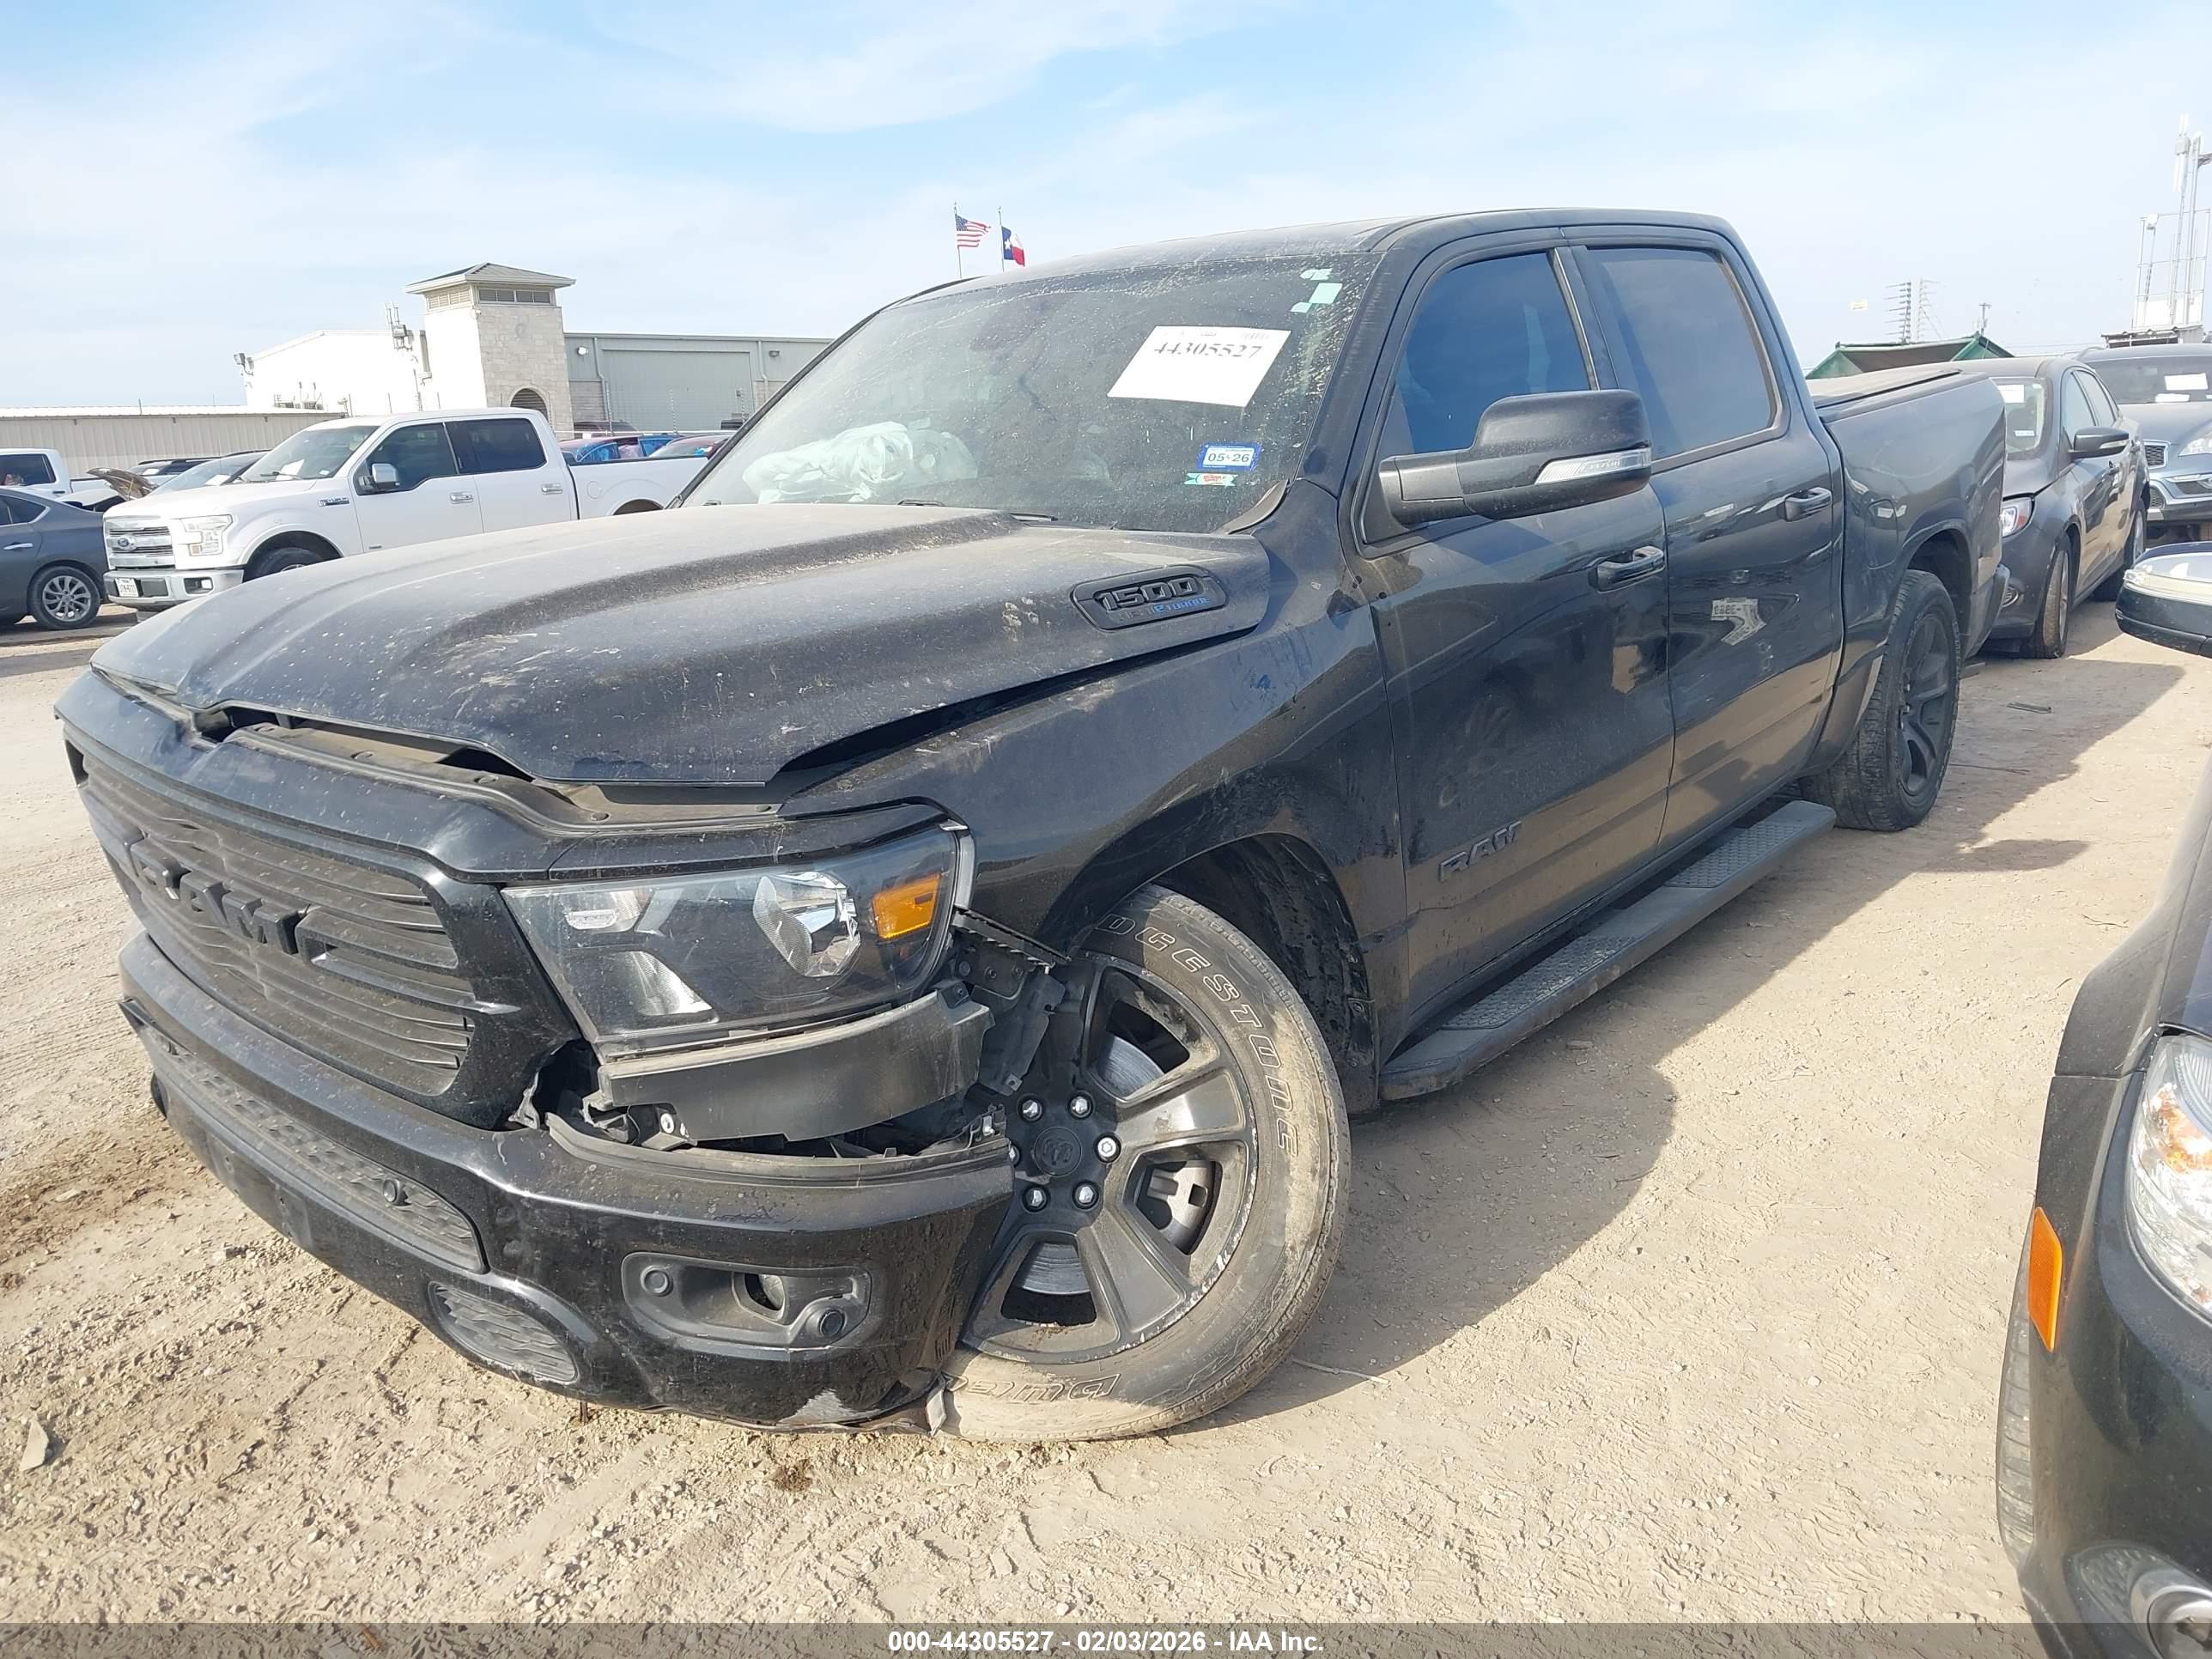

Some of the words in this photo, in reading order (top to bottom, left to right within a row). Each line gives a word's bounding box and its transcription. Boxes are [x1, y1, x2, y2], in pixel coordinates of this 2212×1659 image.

[1153, 342, 1262, 358] 44305527
[1098, 577, 1199, 611] 1500
[1437, 819, 1522, 884] RAM
[129, 837, 299, 955] RAM
